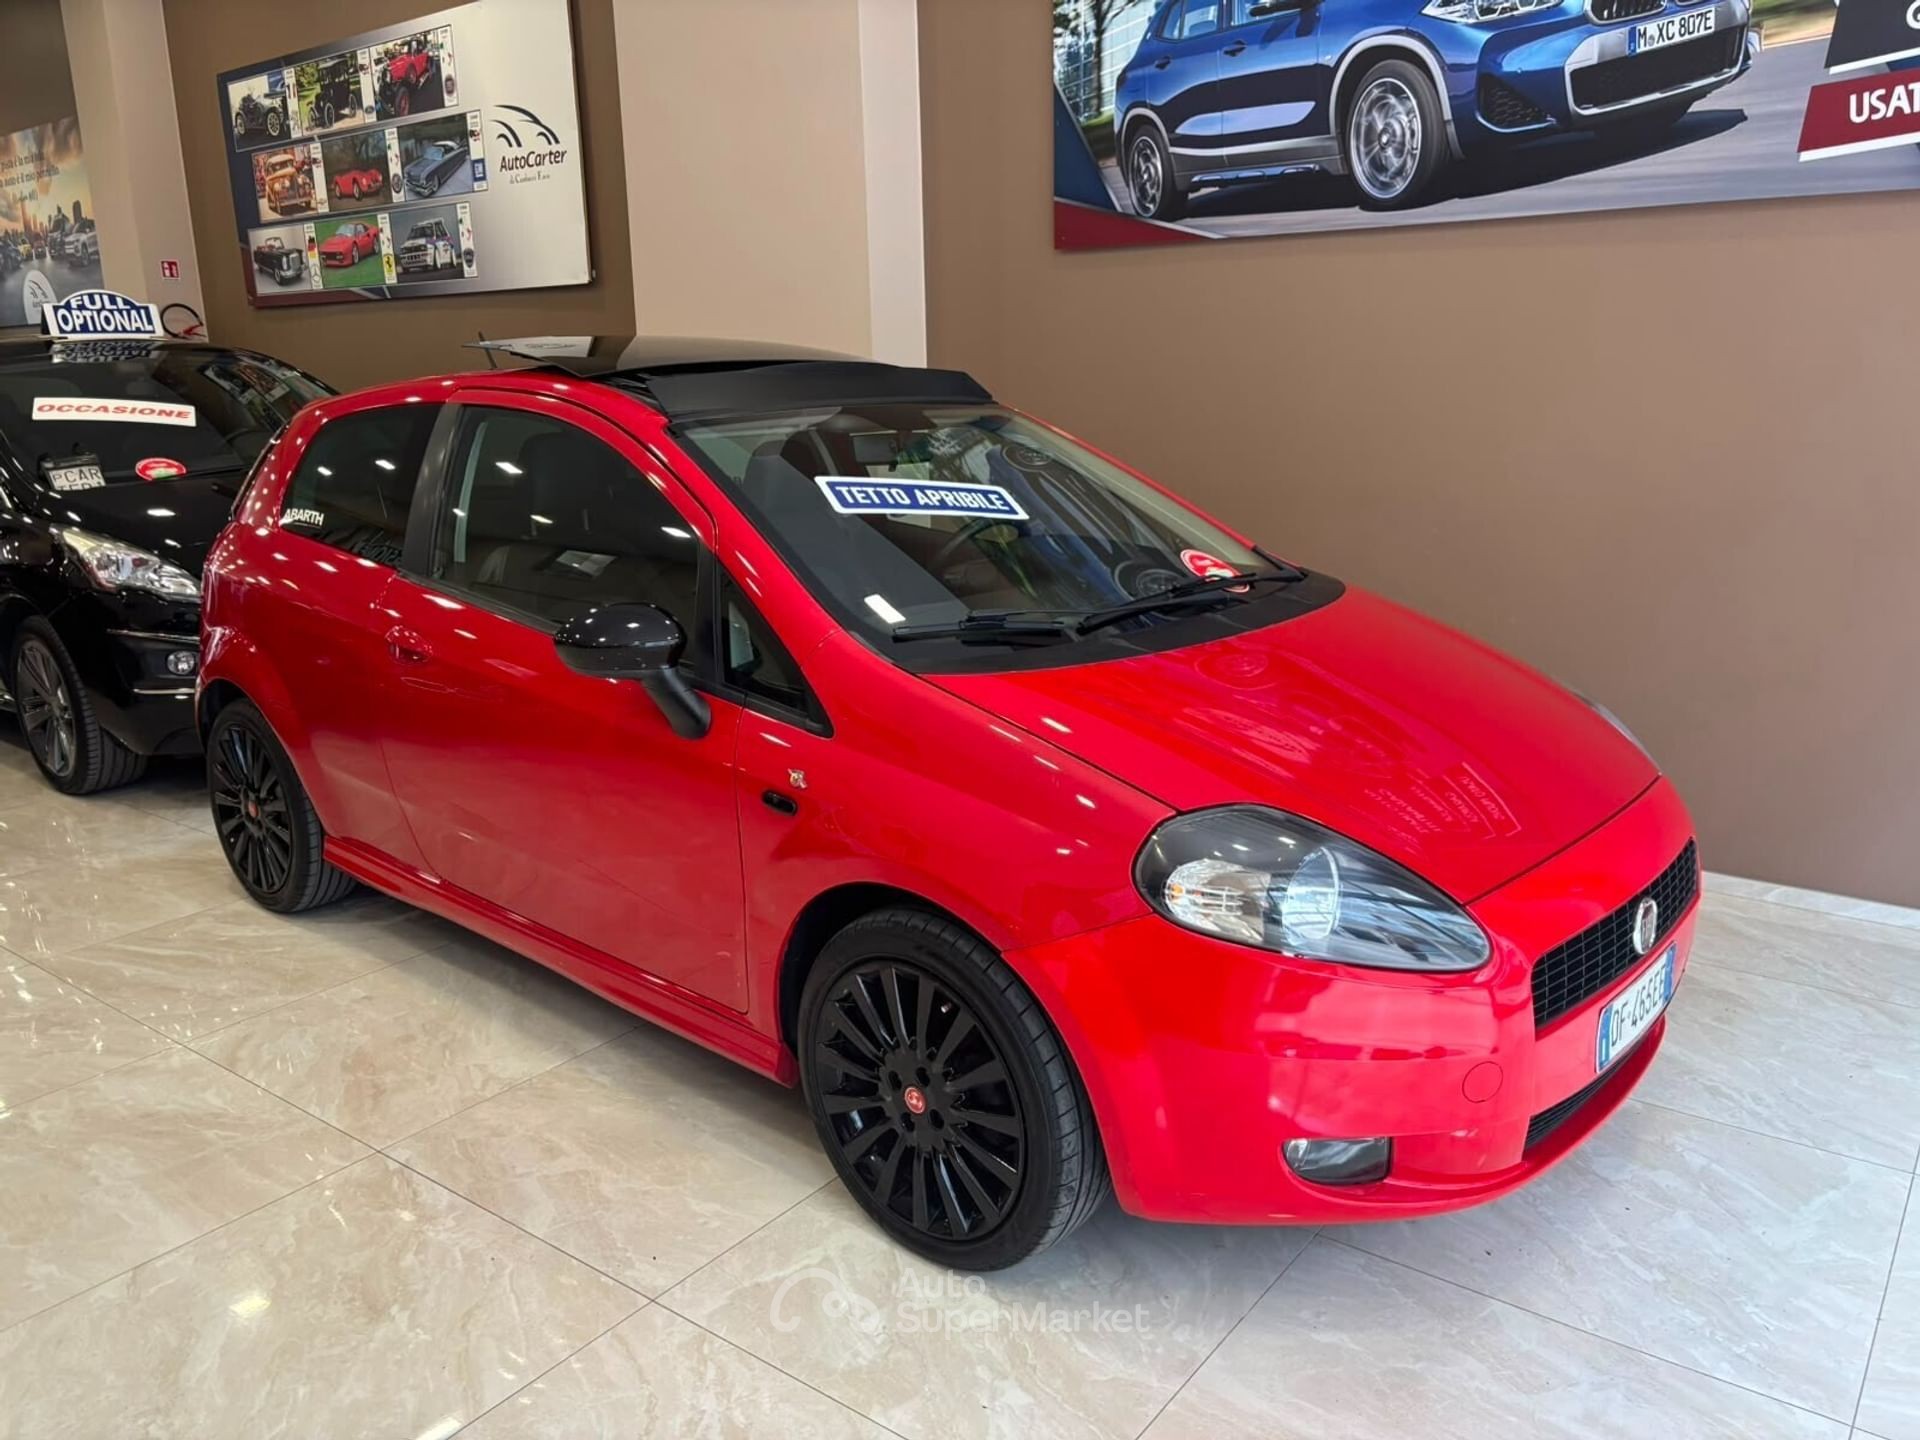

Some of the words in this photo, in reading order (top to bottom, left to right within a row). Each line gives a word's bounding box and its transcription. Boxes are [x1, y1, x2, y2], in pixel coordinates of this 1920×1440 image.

[1637, 26, 1647, 49] M
[1656, 20, 1675, 44] XC
[1678, 9, 1713, 38] 807E
[499, 150, 567, 172] AutoCarter
[69, 294, 131, 310] FULL
[57, 309, 155, 332] OPTIONAL
[36, 403, 192, 419] OCCASIONE
[835, 486, 911, 505] TETTO
[913, 489, 1010, 511] APRIBILE
[283, 508, 325, 526] ABARTH
